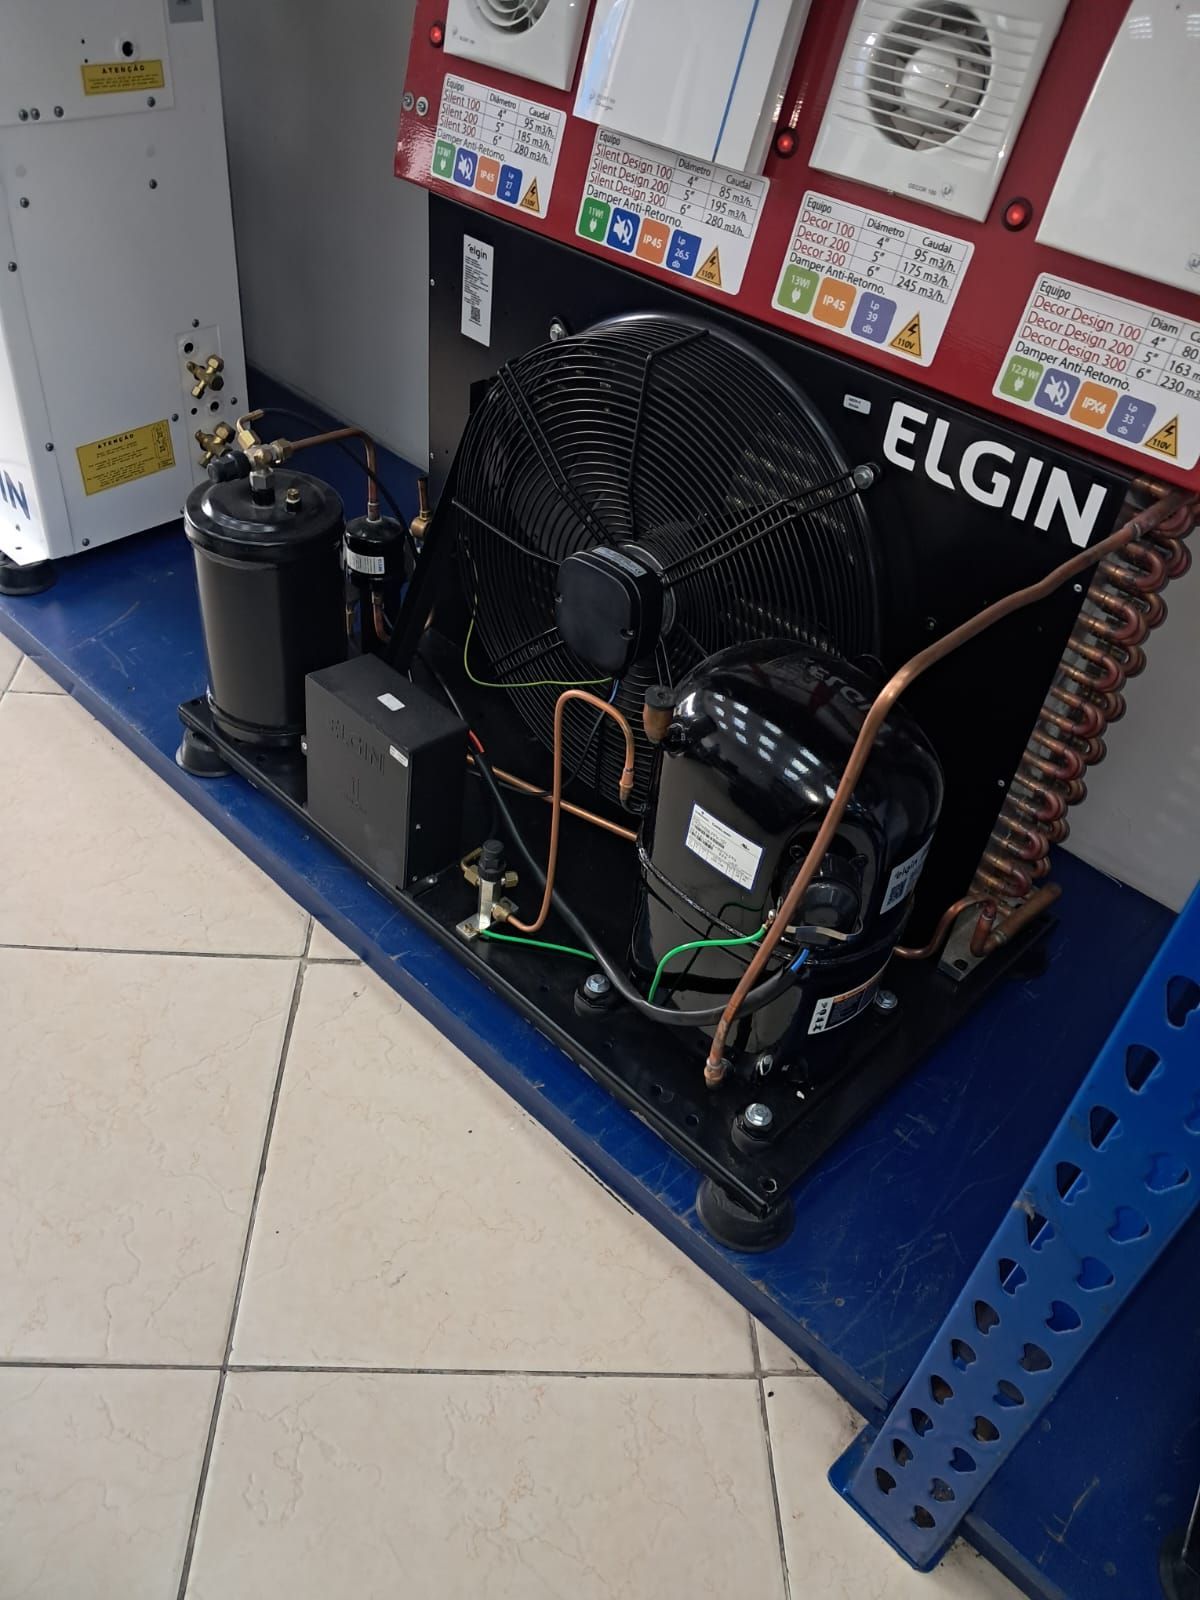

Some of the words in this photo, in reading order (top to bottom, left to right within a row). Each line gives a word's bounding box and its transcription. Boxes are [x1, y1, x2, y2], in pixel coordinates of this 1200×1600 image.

[444, 90, 464, 104] Silent
[467, 99, 480, 112] 100
[524, 118, 534, 130] 95
[447, 78, 464, 91] Equipo
[529, 107, 550, 120] Caudal
[438, 129, 462, 146] Damper
[440, 115, 460, 130] Silent
[463, 124, 476, 137] 300
[515, 143, 528, 157] 280
[442, 103, 462, 118] Silent
[464, 111, 478, 125] 200
[518, 130, 530, 143] 185
[596, 144, 621, 162] Silent
[623, 153, 654, 173] Design
[656, 165, 672, 180] 100
[719, 186, 730, 200] 85
[732, 195, 753, 207] m3/h.
[600, 131, 620, 146] Equipo
[726, 174, 752, 190] Caudal
[587, 185, 622, 207] Damper
[623, 198, 683, 228] Anti-Retorno.
[590, 171, 614, 188] Silent
[616, 180, 646, 201] Design
[650, 192, 665, 208] 300
[706, 213, 723, 228] 280
[725, 223, 745, 237] m3/h.
[592, 158, 617, 176] Silent
[619, 166, 650, 187] Design
[651, 179, 668, 194] 200
[711, 199, 726, 213] 195
[643, 234, 663, 248] IP45
[678, 236, 686, 246] Lp
[802, 210, 834, 231] Decor
[837, 222, 855, 239] 100
[914, 248, 928, 262] 95
[929, 257, 956, 273] m3/h.
[807, 197, 832, 215] Equipo
[867, 218, 905, 238] Diámetro
[922, 237, 952, 253] Caudal
[701, 269, 717, 280] 110V
[790, 252, 825, 273] Damper
[825, 265, 885, 295] Anti-Retorno.
[793, 238, 825, 260] Decor
[827, 249, 846, 267] 300
[897, 276, 916, 293] 245
[918, 286, 945, 303] m3/h.
[797, 225, 829, 246] Decor
[830, 236, 850, 253] 200
[903, 262, 921, 278] 175
[923, 272, 949, 288] m3/h.
[822, 294, 846, 312] IP45
[866, 311, 878, 322] 39
[870, 301, 880, 311] Lp
[1040, 281, 1071, 300] Equipo
[1151, 317, 1179, 335] Diam
[862, 324, 873, 334] db
[898, 338, 915, 350] 110V
[1027, 310, 1063, 333] Decor
[1065, 323, 1108, 349] Design
[1109, 339, 1134, 357] 200
[1170, 360, 1191, 376] 163
[1033, 295, 1069, 317] Decor
[1072, 307, 1114, 333] Design
[1117, 323, 1142, 341] 100
[1182, 346, 1199, 360] 80
[1015, 340, 1059, 365] Damper
[1059, 357, 1131, 392] Anti-Retorno.
[1022, 325, 1057, 348] Decor
[1058, 339, 1100, 364] Design
[1102, 353, 1127, 372] 300
[1160, 376, 1184, 393] 230
[1082, 397, 1106, 415] IPX4
[1122, 414, 1135, 425] 33
[1128, 402, 1138, 413] Lp
[1117, 425, 1128, 435] db
[1153, 439, 1171, 450] 110V
[883, 401, 1108, 548] ELGIN
